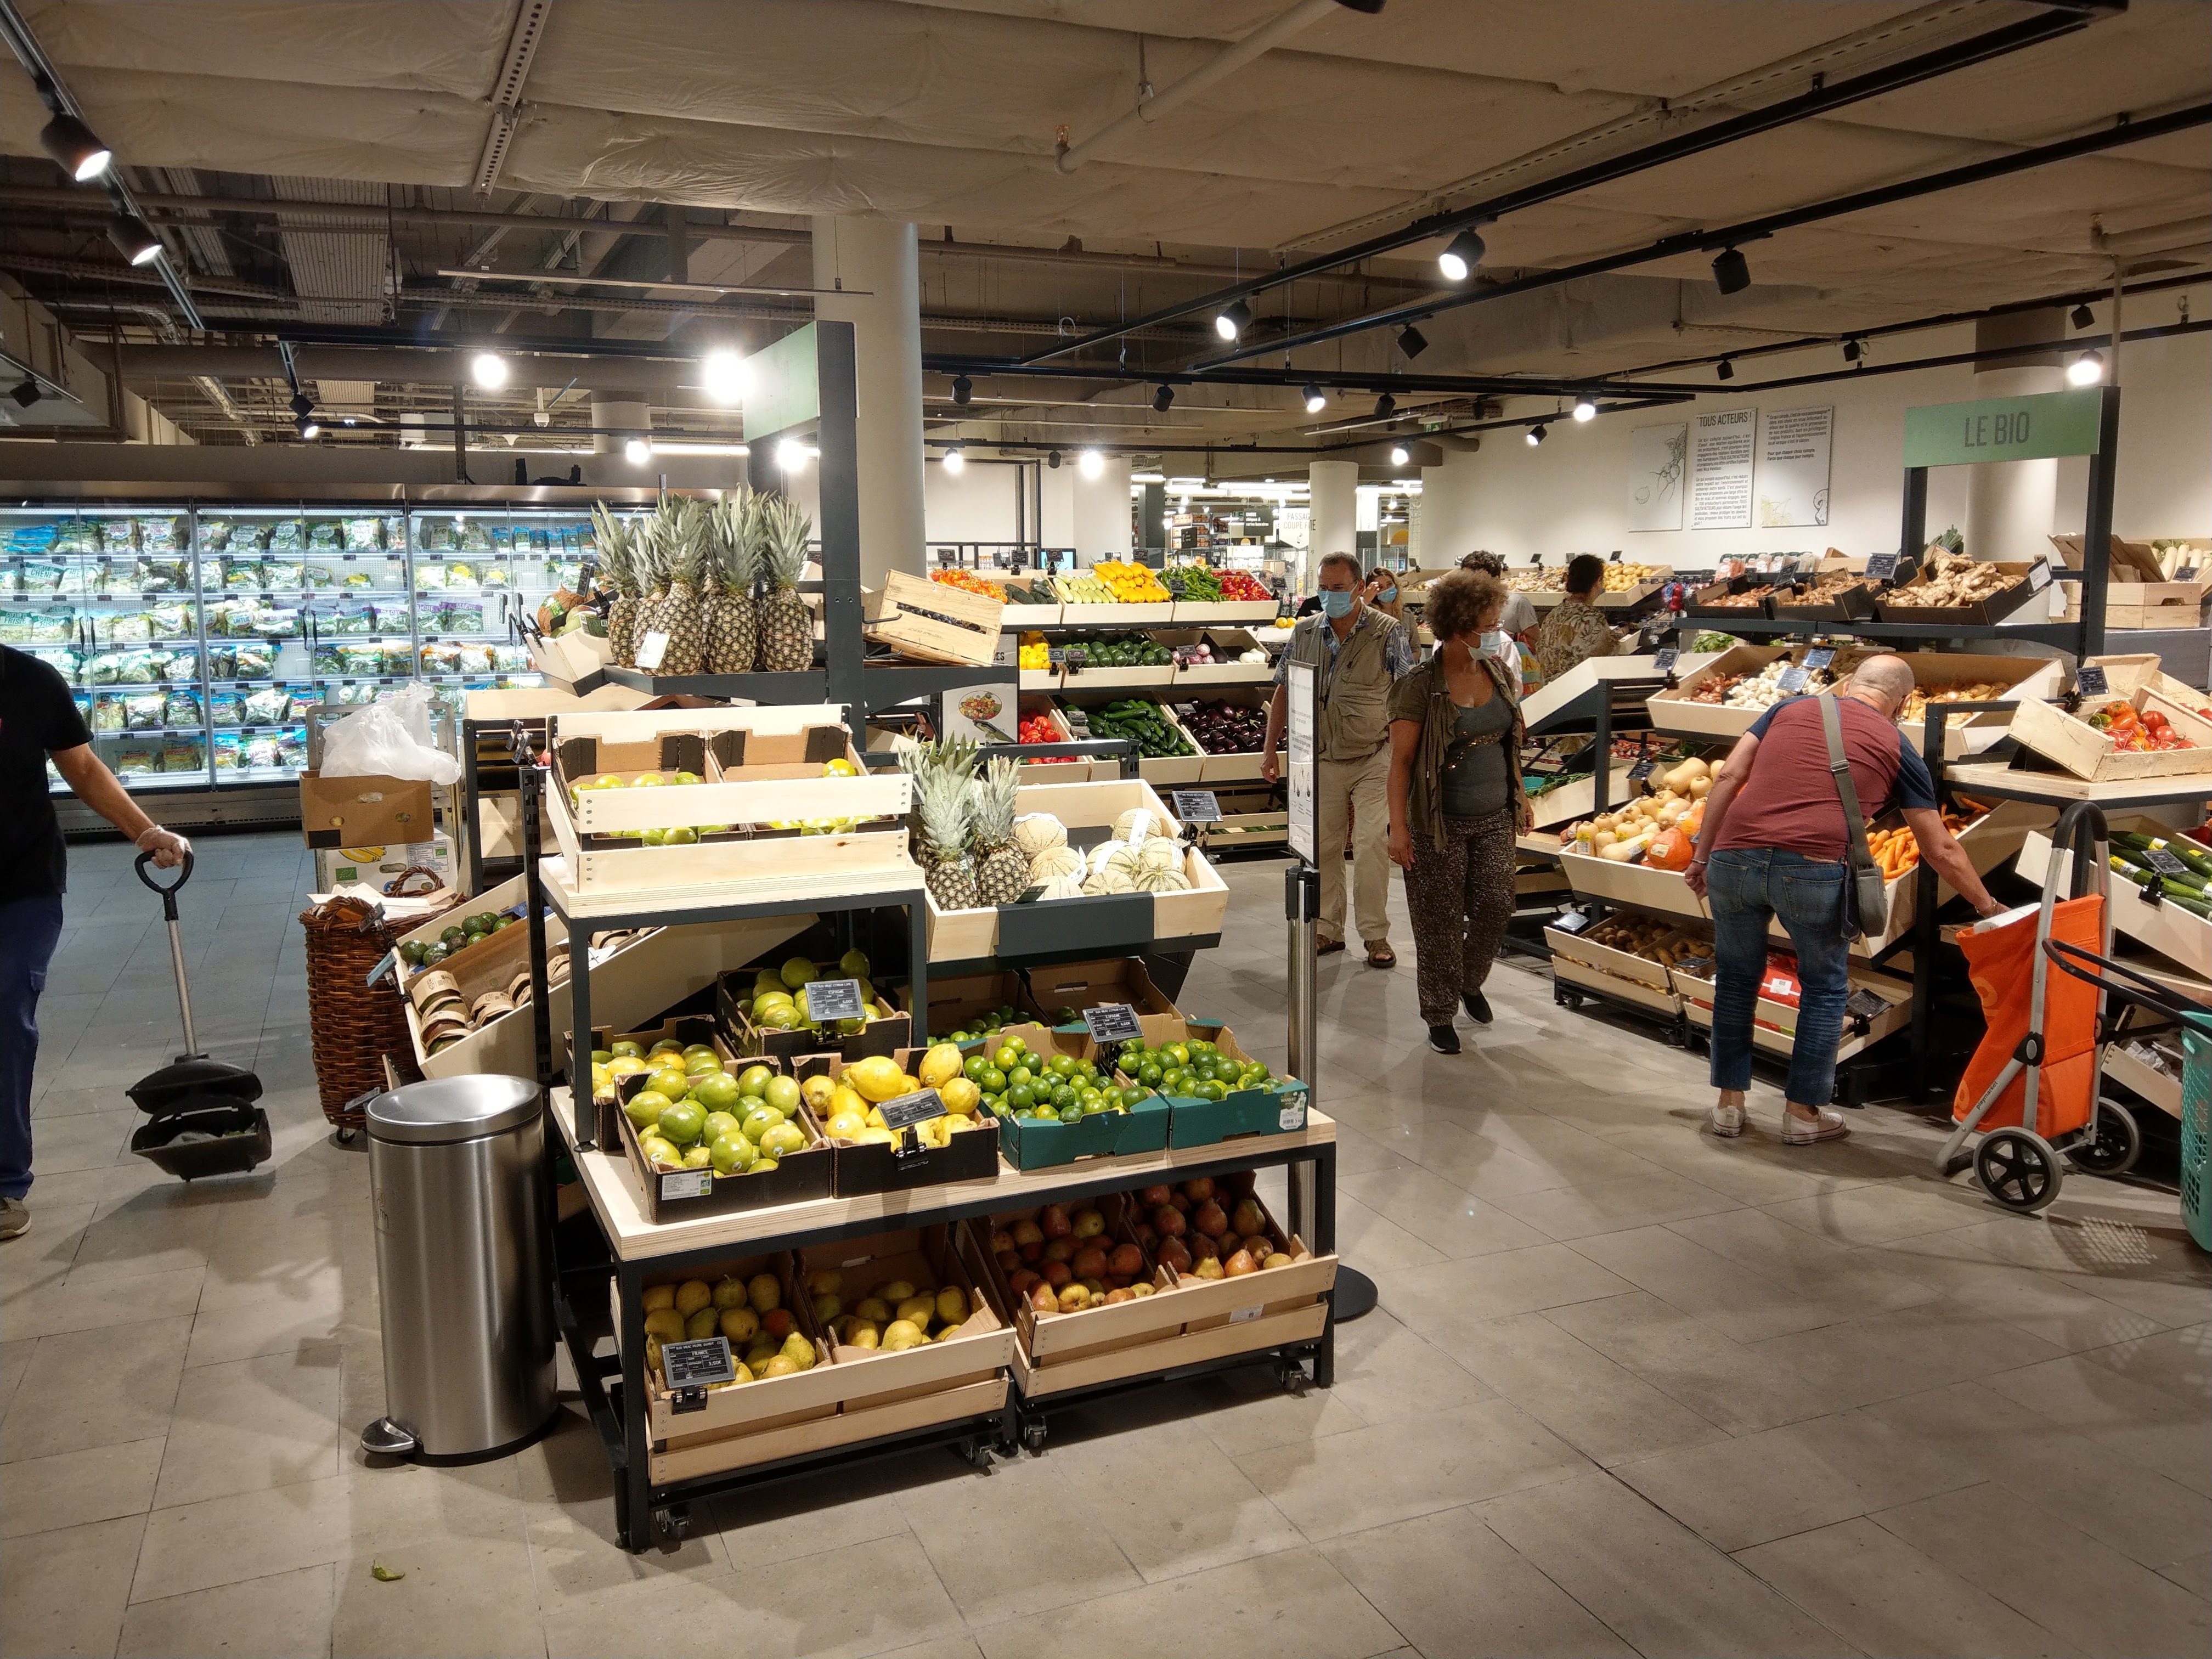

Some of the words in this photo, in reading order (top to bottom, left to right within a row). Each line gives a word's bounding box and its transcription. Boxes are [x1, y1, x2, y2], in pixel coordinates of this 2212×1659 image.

[1700, 415, 1716, 427] TOUS
[1718, 412, 1748, 425] ACTEURS
[1964, 415, 1989, 448] LE
[1994, 411, 2030, 445] BIO
[1976, 1081, 1999, 1110] playmarket
